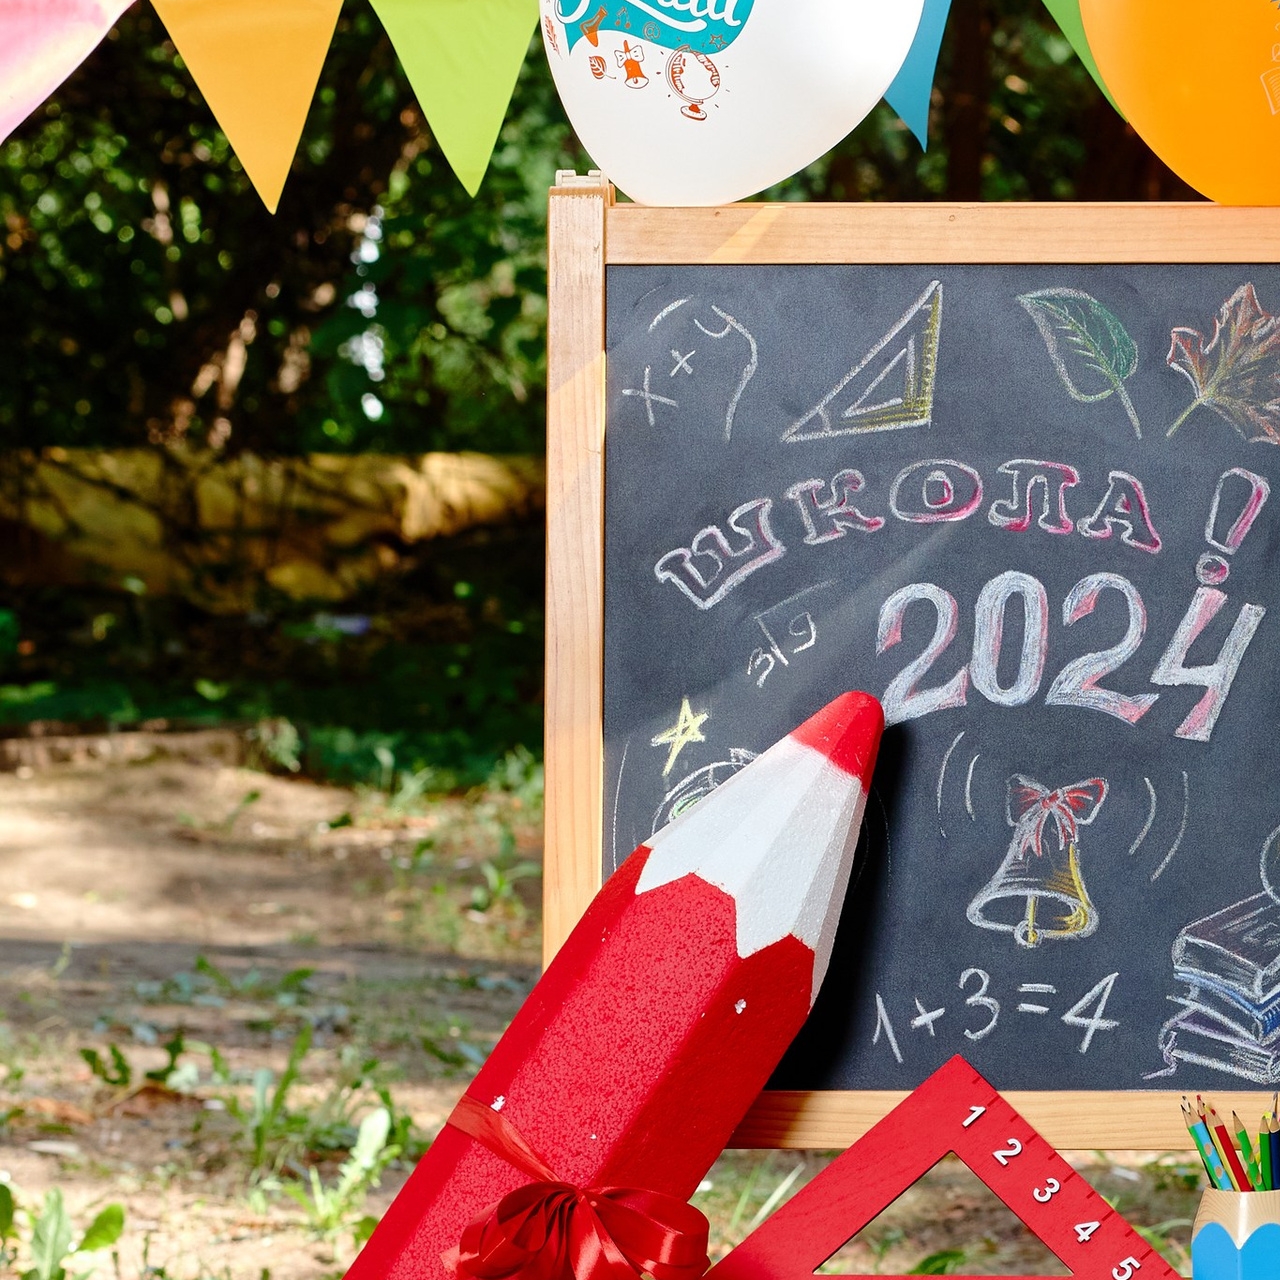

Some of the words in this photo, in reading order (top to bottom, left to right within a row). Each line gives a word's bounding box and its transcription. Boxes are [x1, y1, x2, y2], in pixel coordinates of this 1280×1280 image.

[875, 569, 1267, 742] 2024
[962, 1105, 987, 1128] 1
[992, 1138, 1023, 1166] 2
[1033, 1177, 1061, 1204] 3
[1073, 1220, 1101, 1244] 4
